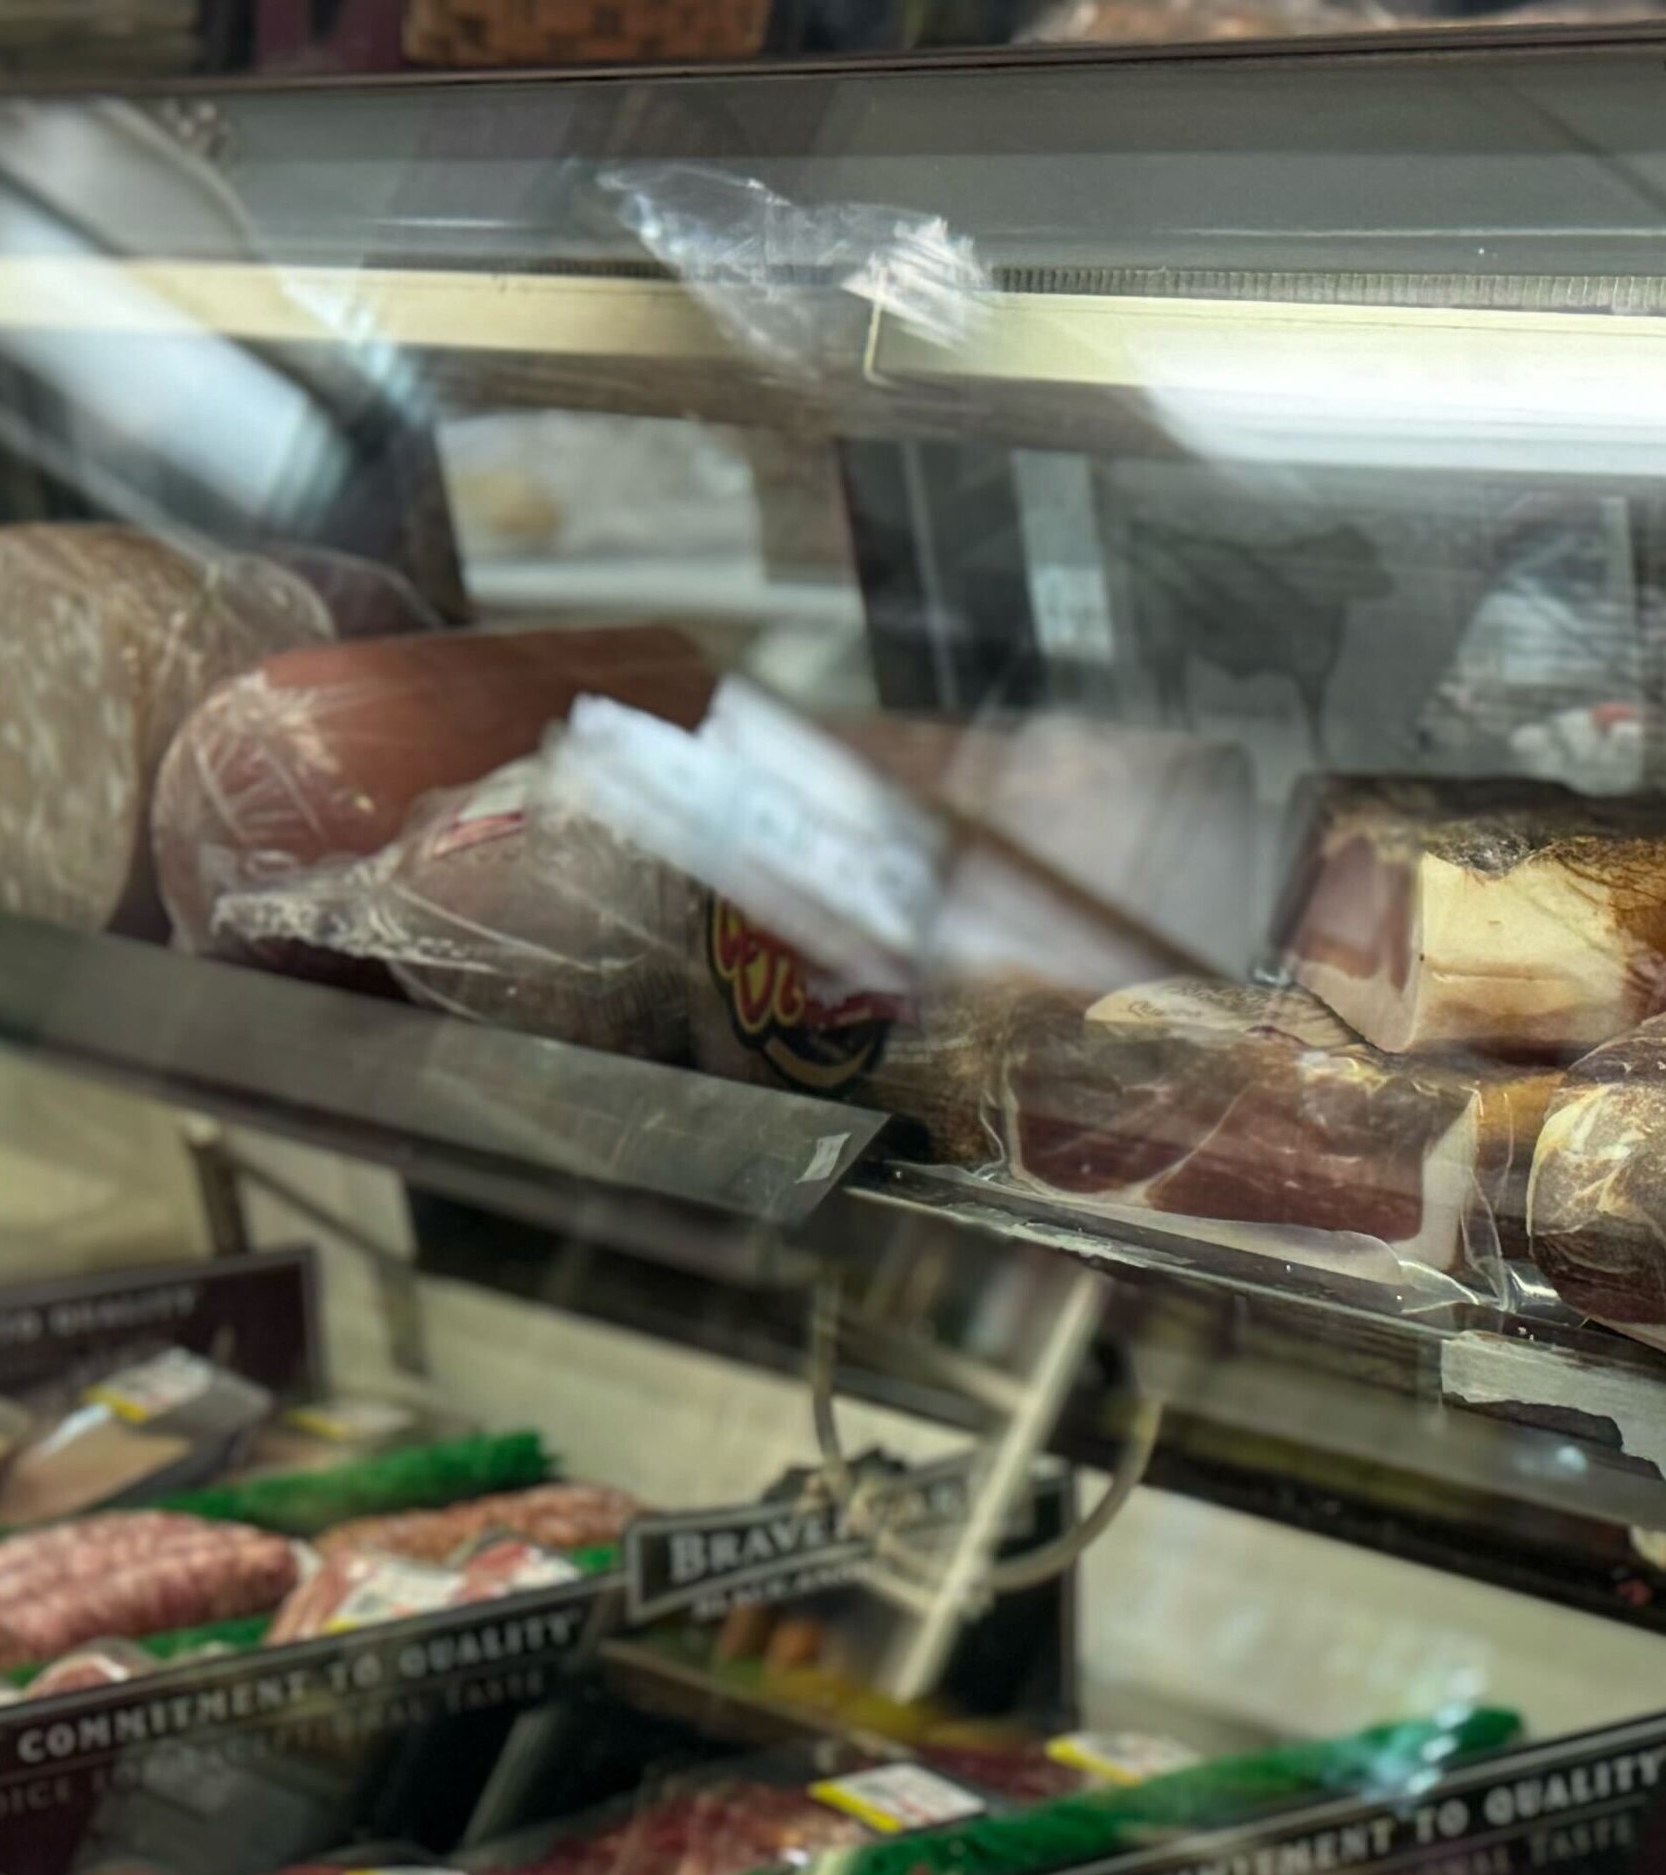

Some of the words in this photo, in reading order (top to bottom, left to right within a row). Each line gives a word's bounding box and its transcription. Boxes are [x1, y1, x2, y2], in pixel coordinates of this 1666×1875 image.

[17, 1669, 306, 1763] COMMITMENT
[329, 1652, 383, 1692] TO
[1416, 1800, 1470, 1844] TO
